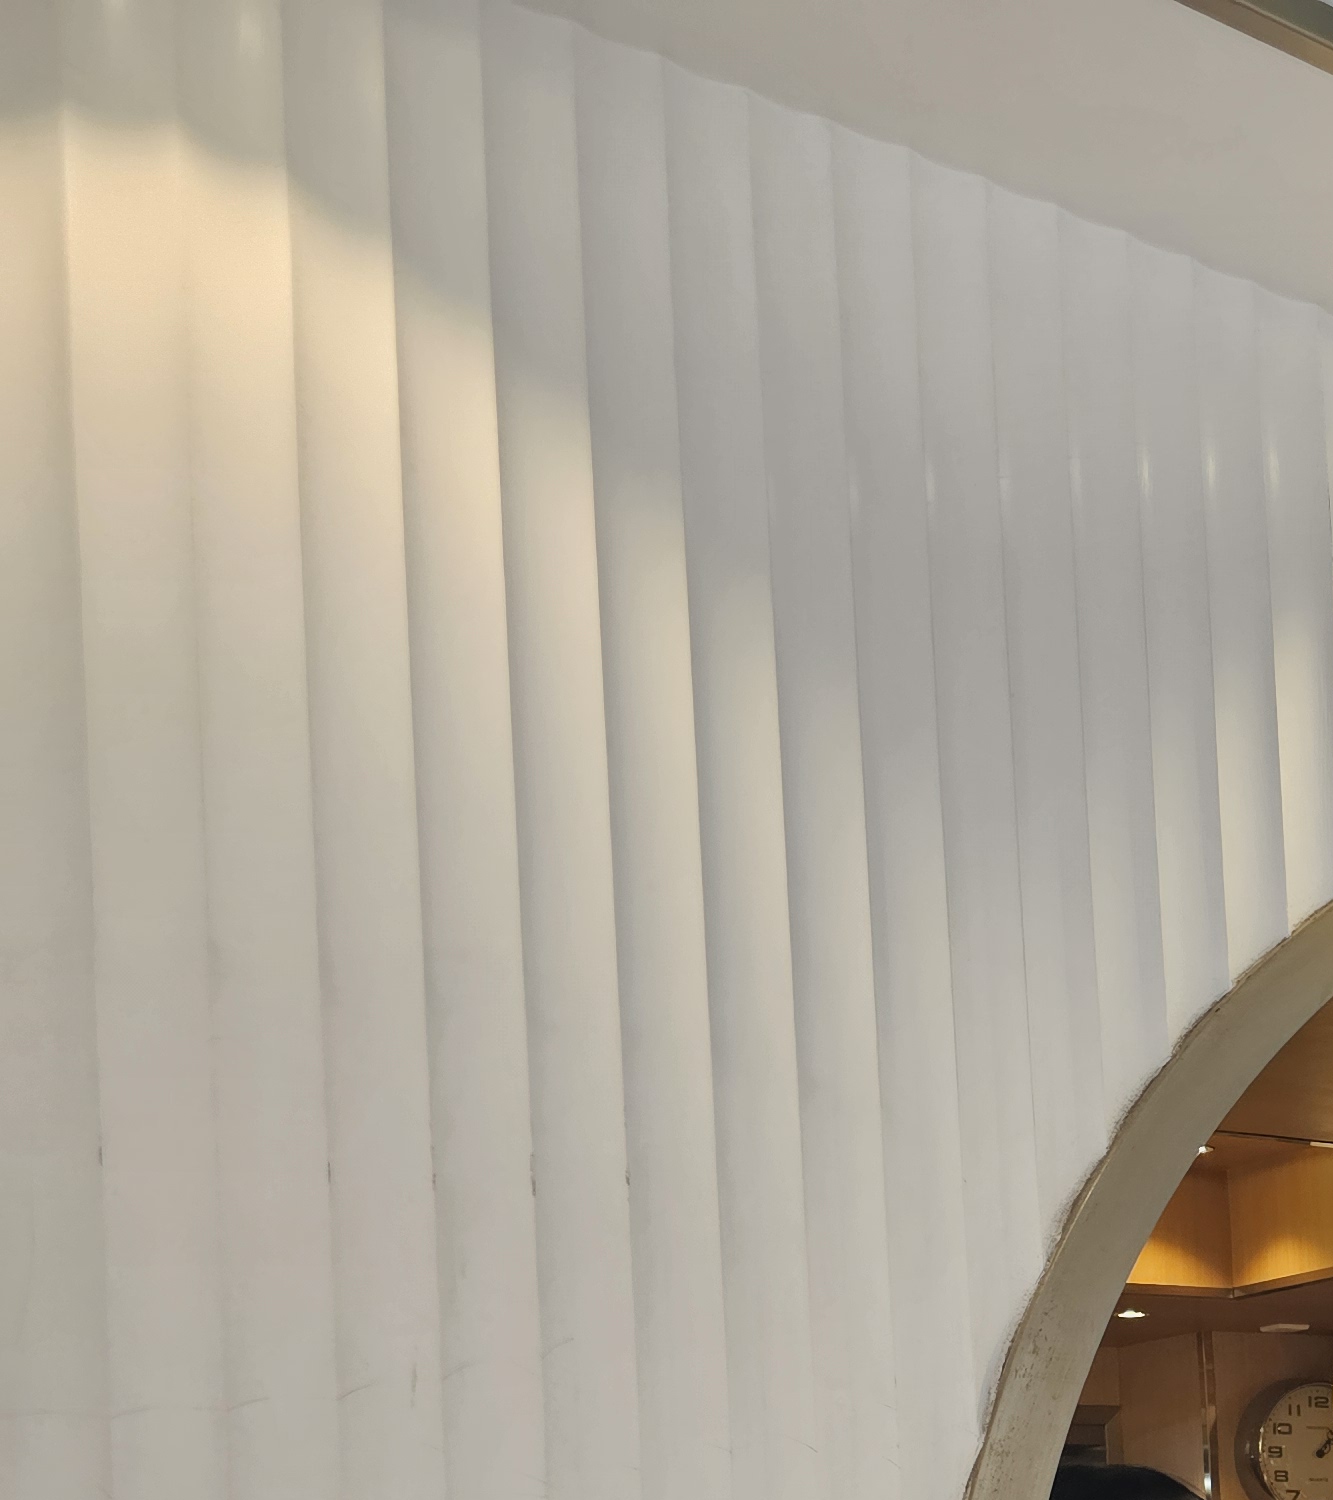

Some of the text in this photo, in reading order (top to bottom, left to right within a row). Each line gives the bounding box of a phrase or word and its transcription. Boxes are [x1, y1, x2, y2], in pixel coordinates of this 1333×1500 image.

[1308, 1395, 1329, 1408] 12
[1288, 1404, 1301, 1416] 11
[1273, 1423, 1292, 1434] 10
[1268, 1446, 1282, 1458] 9
[1274, 1470, 1288, 1482] 8
